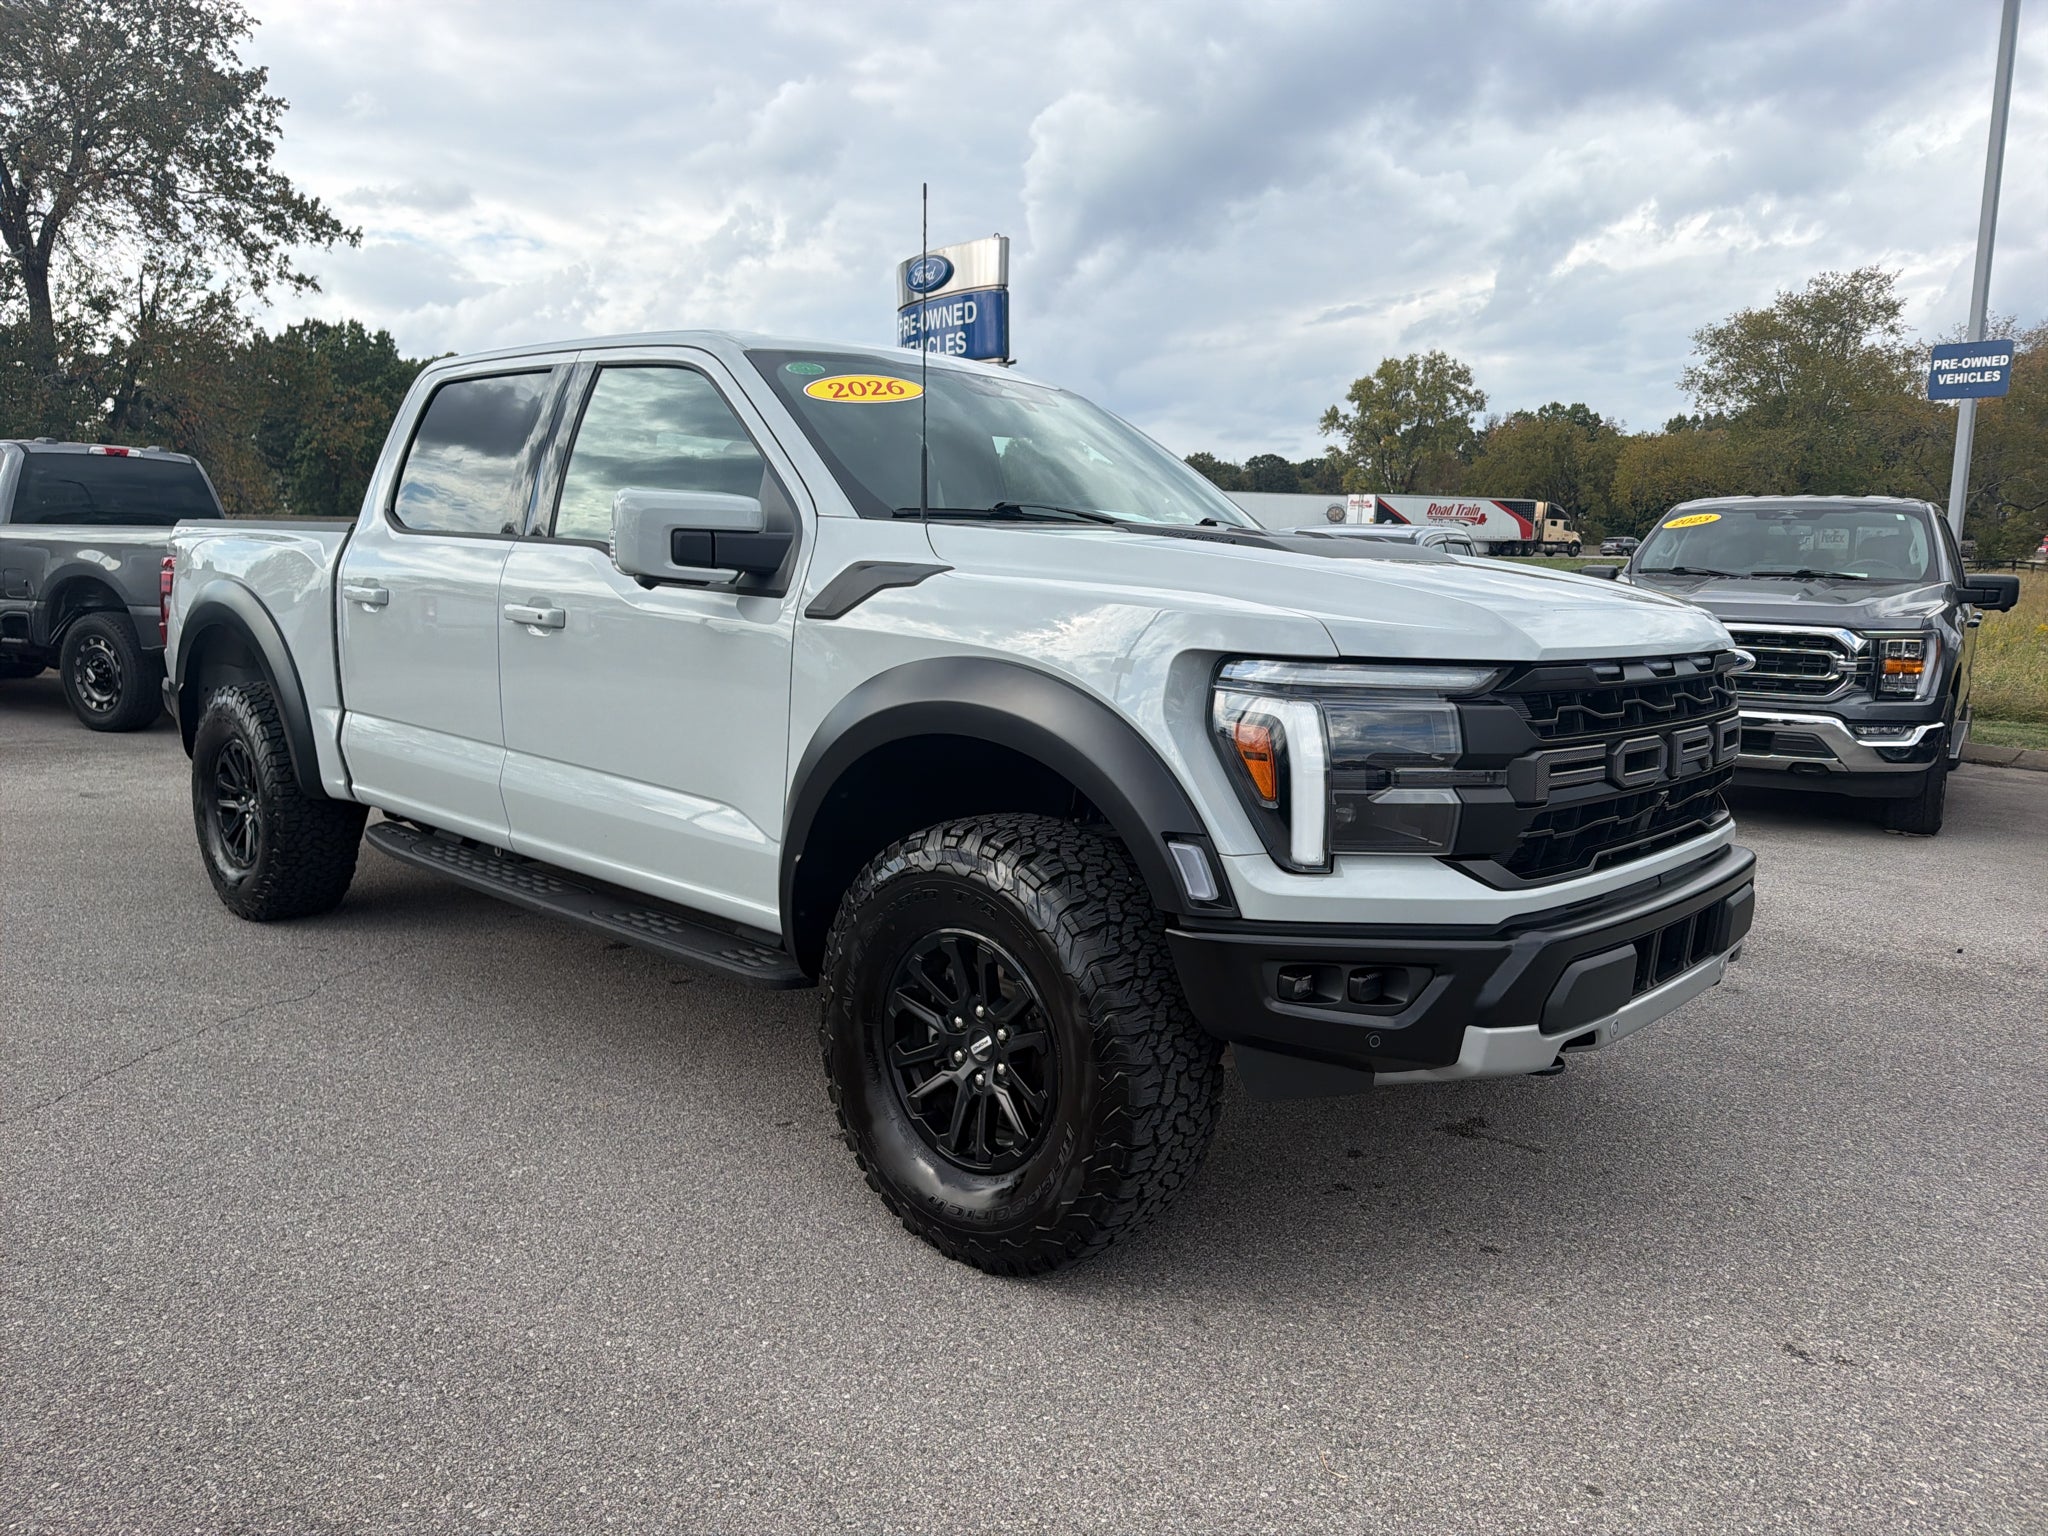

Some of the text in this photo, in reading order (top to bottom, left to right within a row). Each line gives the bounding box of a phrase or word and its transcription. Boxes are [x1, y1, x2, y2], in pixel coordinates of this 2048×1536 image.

[899, 301, 977, 341] PRE-OWNED
[903, 331, 967, 355] HCLES
[1933, 354, 2009, 371] PRE-OWNED
[1938, 370, 2001, 385] VEHICLES
[827, 380, 905, 399] 2026
[1427, 502, 1480, 516] Road Train
[1533, 714, 1742, 801] FORD
